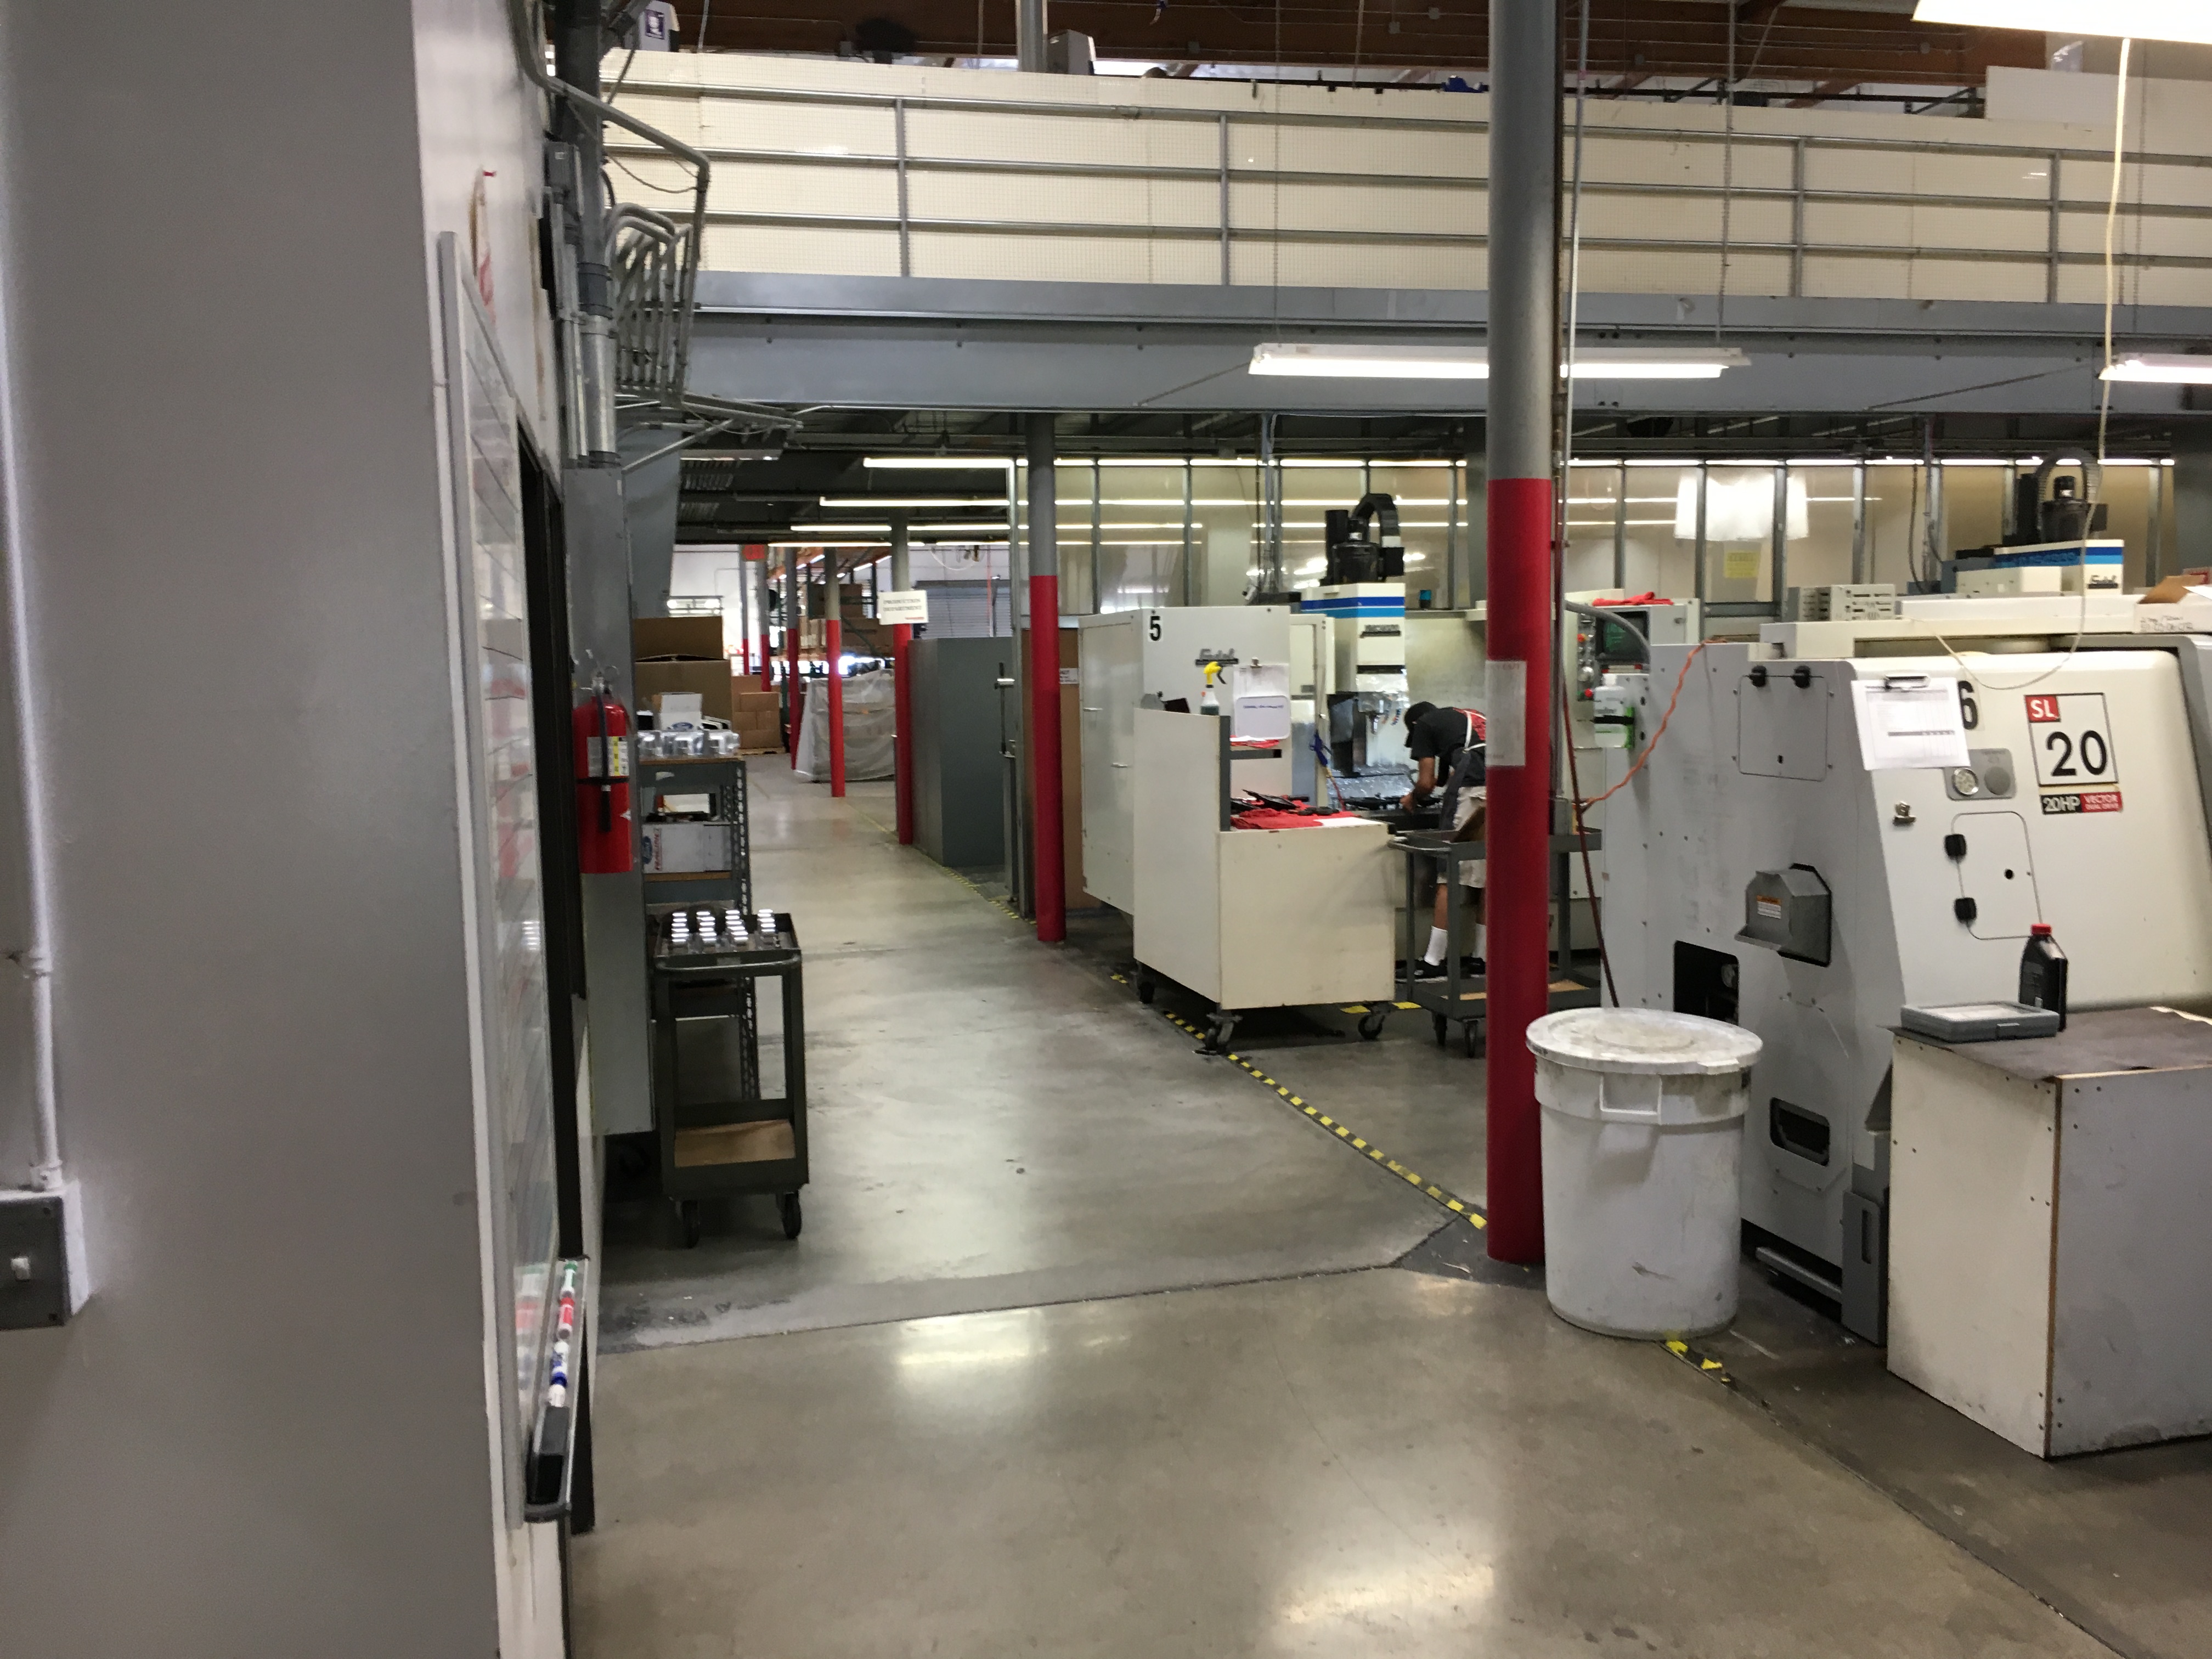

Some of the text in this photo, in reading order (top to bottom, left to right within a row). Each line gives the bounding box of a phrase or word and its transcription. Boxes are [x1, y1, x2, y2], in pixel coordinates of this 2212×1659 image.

[1149, 616, 1162, 641] 5
[1957, 680, 1978, 730] 6
[2030, 699, 2057, 719] SL
[2046, 730, 2107, 777] 20
[2042, 795, 2081, 812] 20HP
